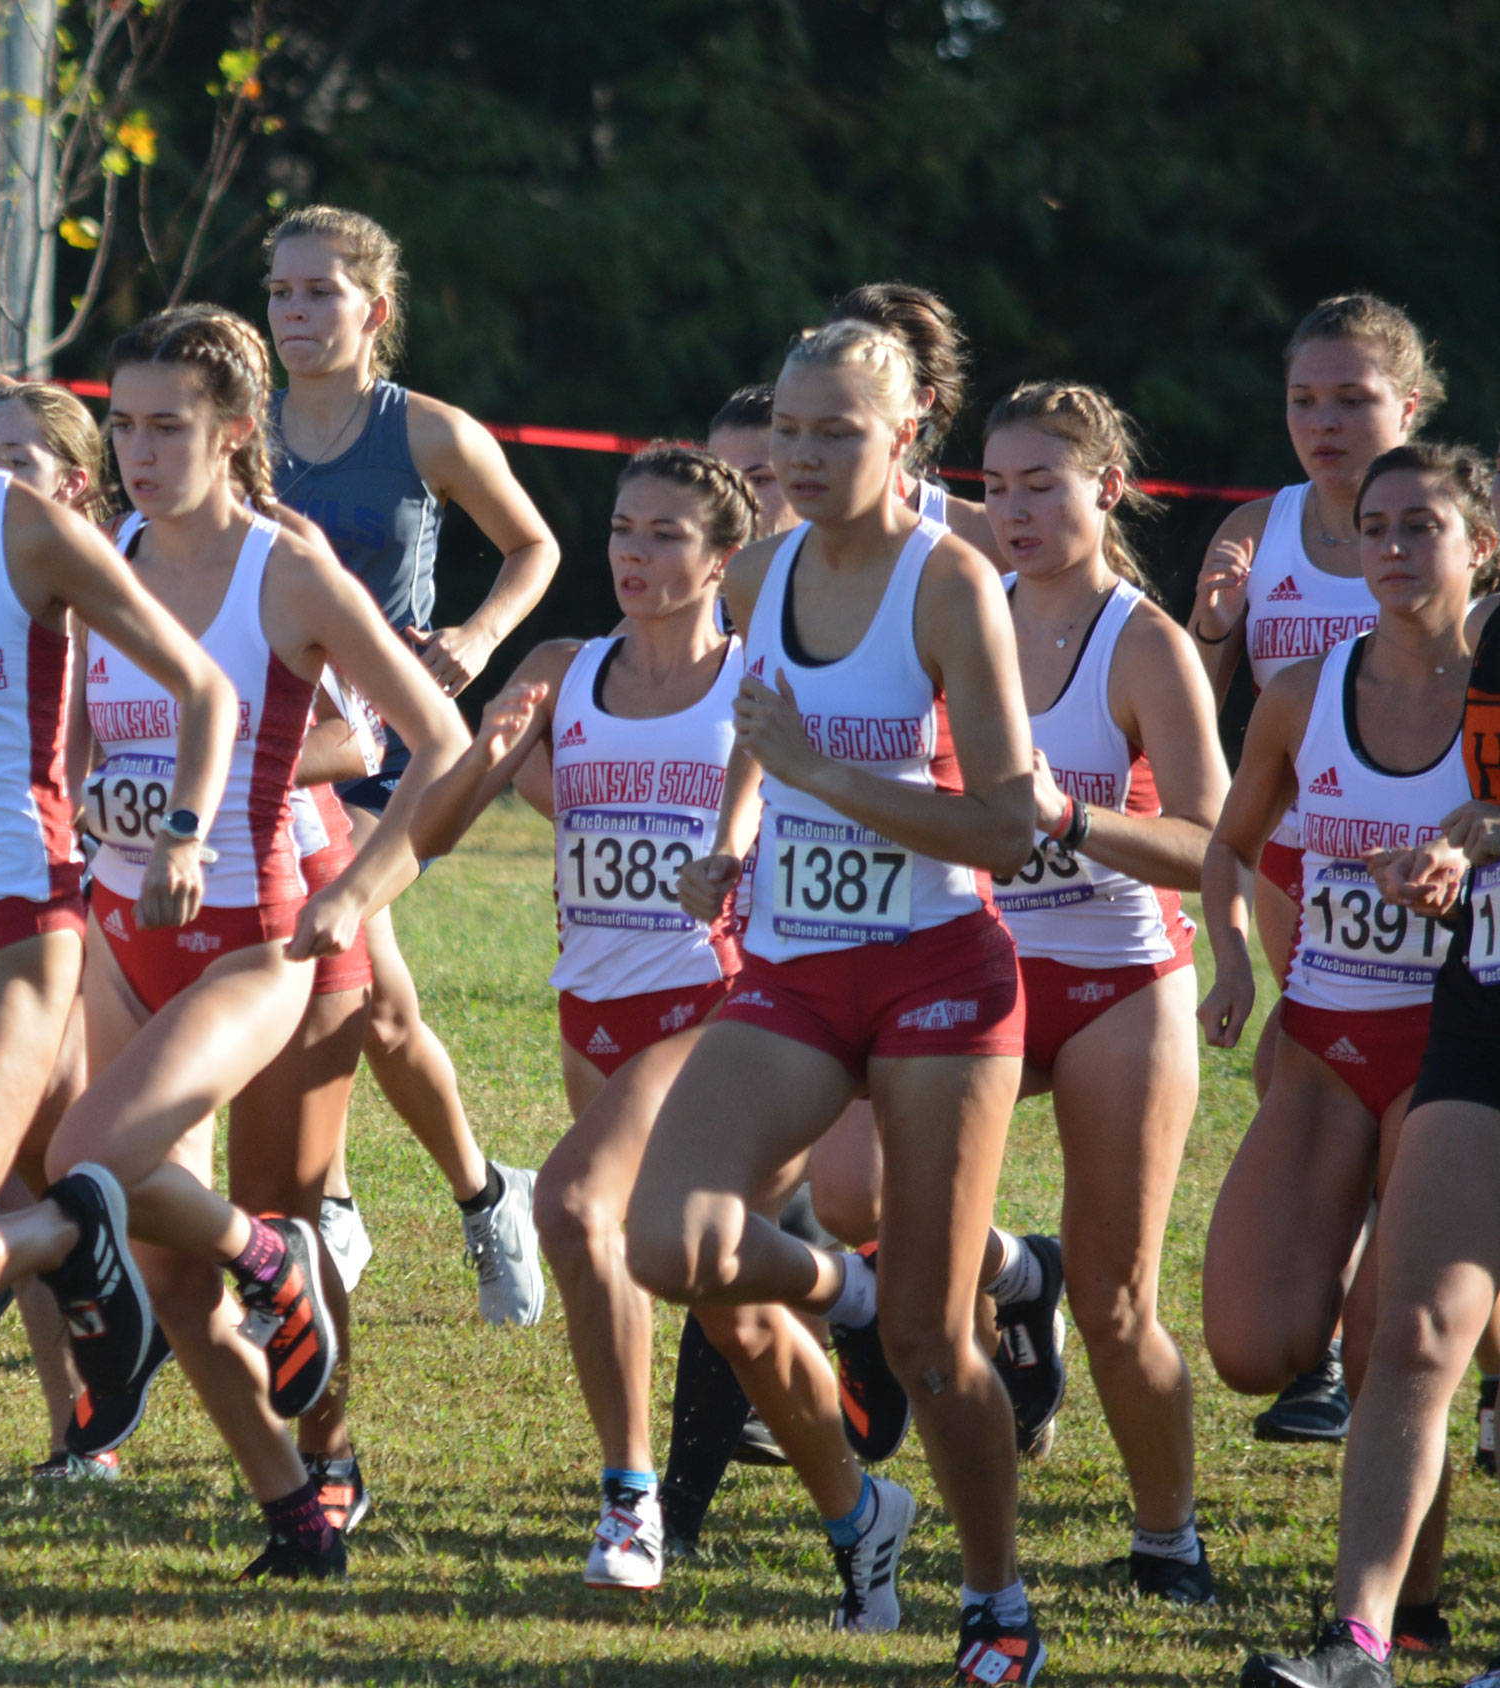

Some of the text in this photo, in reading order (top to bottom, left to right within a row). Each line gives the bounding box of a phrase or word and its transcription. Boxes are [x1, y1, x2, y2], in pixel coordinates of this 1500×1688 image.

[87, 699, 171, 743] KANSAS
[828, 716, 926, 762] STATE
[157, 760, 177, 777] Tim
[657, 761, 726, 811] STAT
[1050, 768, 1116, 807] ATE
[87, 777, 168, 839] 138
[1308, 784, 1343, 798] adidas
[572, 814, 690, 837] MacDonald Timing
[783, 819, 892, 846] MacDonald Tim
[1304, 813, 1410, 860] ARKANSAS
[568, 837, 693, 903] 1383
[779, 845, 906, 916] 1387
[575, 910, 681, 929] MacDonaldTiming.com
[779, 919, 895, 943] MacDonaldTiming.com
[1311, 887, 1435, 957] 1391
[1312, 954, 1432, 982] MacDonaldTiming.com
[897, 1000, 978, 1031] STATE
